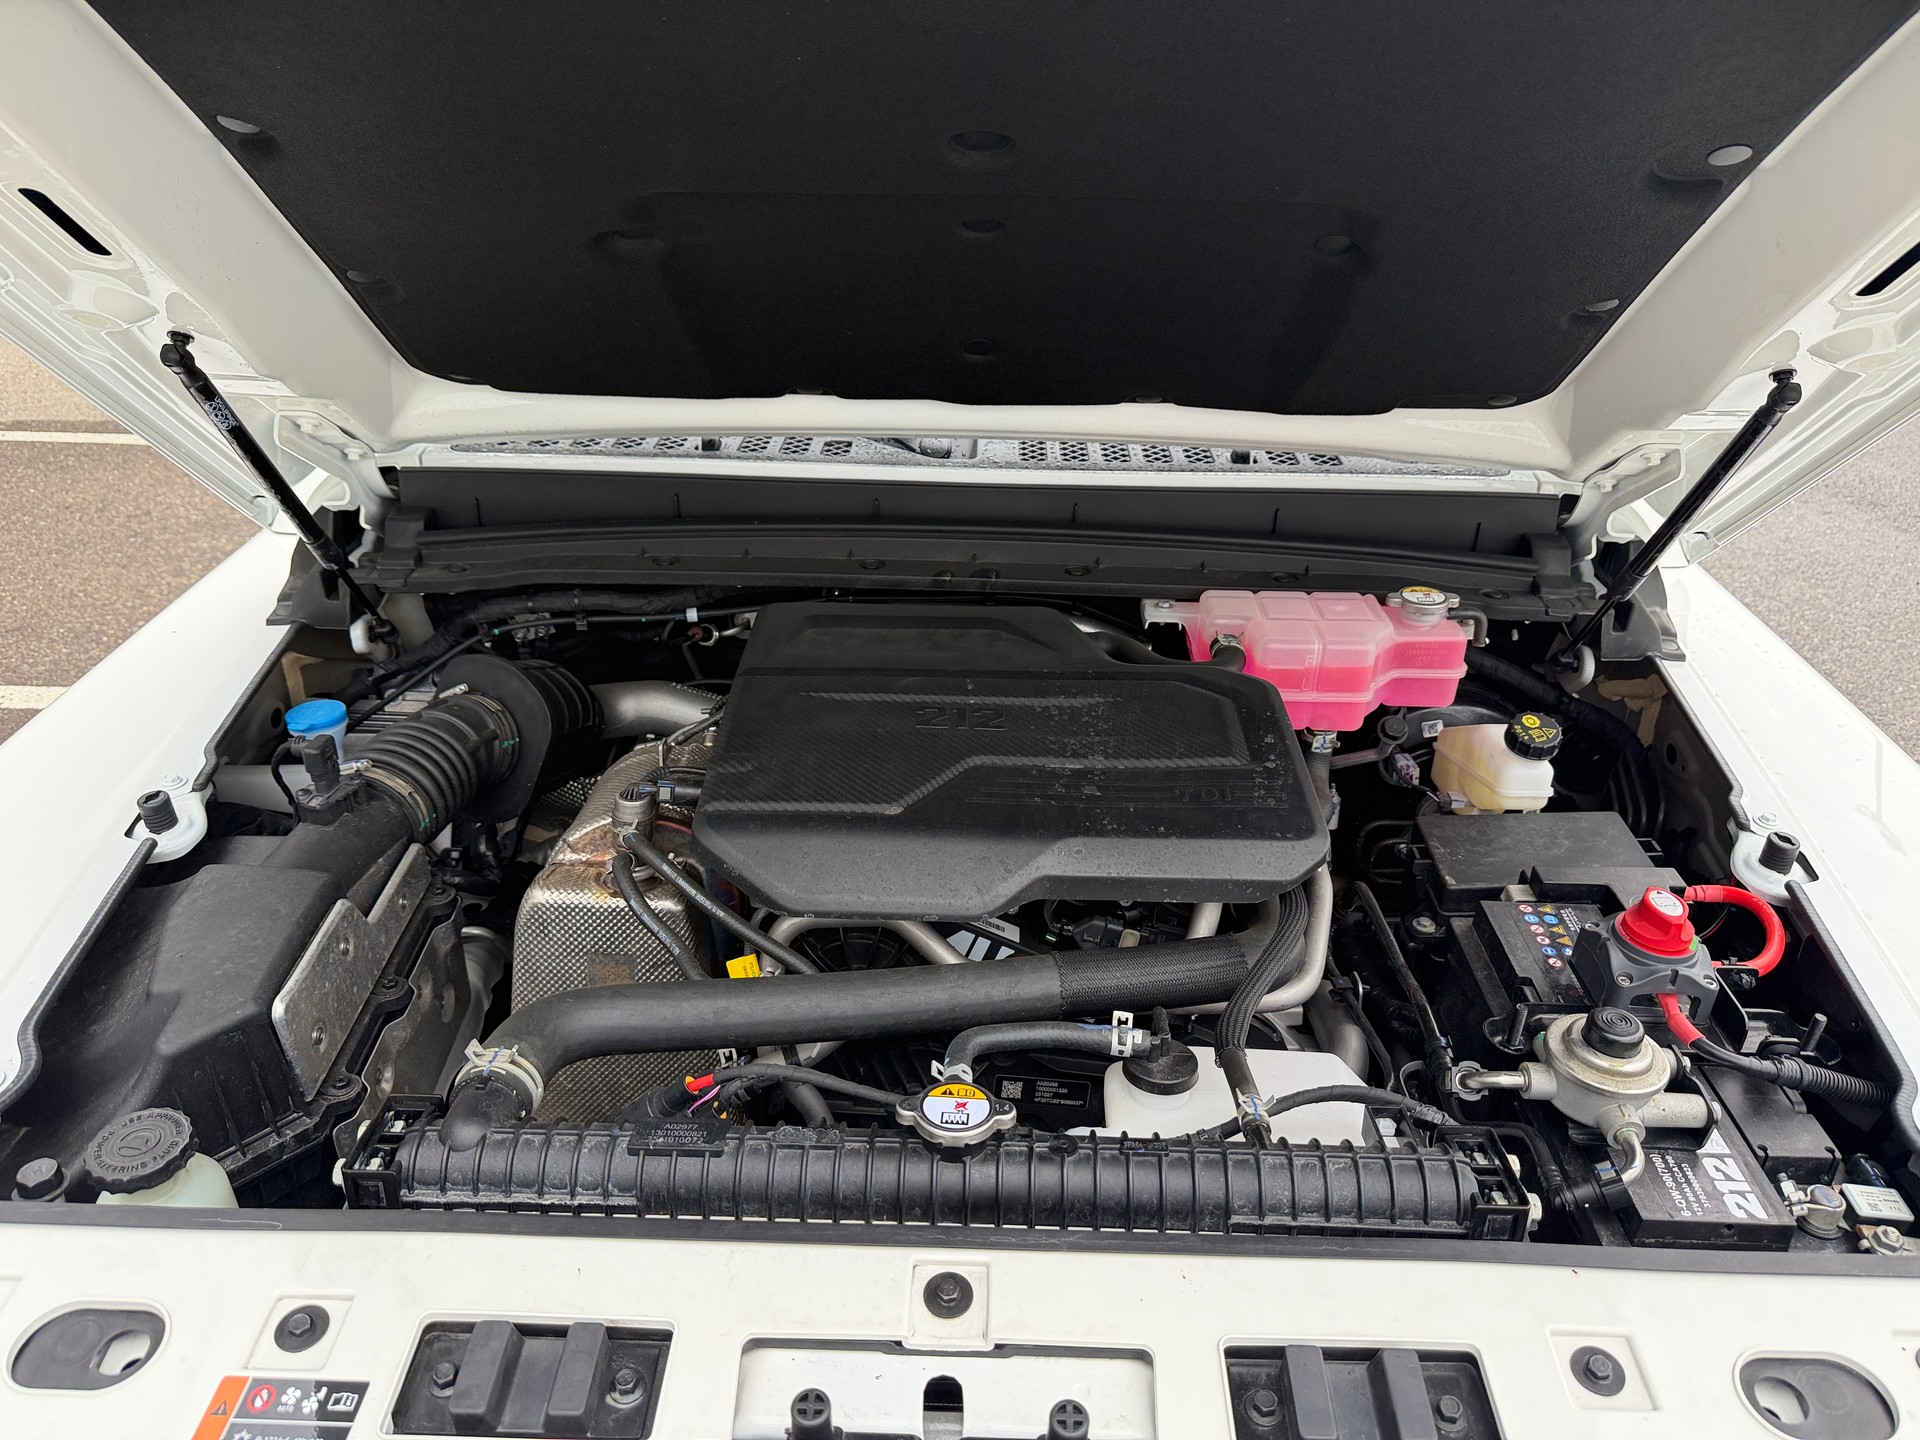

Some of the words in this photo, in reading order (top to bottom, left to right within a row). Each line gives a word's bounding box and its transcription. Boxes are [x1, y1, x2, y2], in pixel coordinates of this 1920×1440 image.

[915, 706, 1007, 731] 212
[1174, 786, 1232, 802] TDI
[995, 1103, 1010, 1112] 1.4
[651, 1129, 708, 1137] 13010000821
[663, 1122, 699, 1130] A02977
[96, 1159, 148, 1173] STEERING
[151, 1139, 179, 1162] FLUID
[1649, 1153, 1691, 1217] 6-QW-90(700)
[1701, 1157, 1769, 1219] 212
[276, 1404, 295, 1413] AUTO
